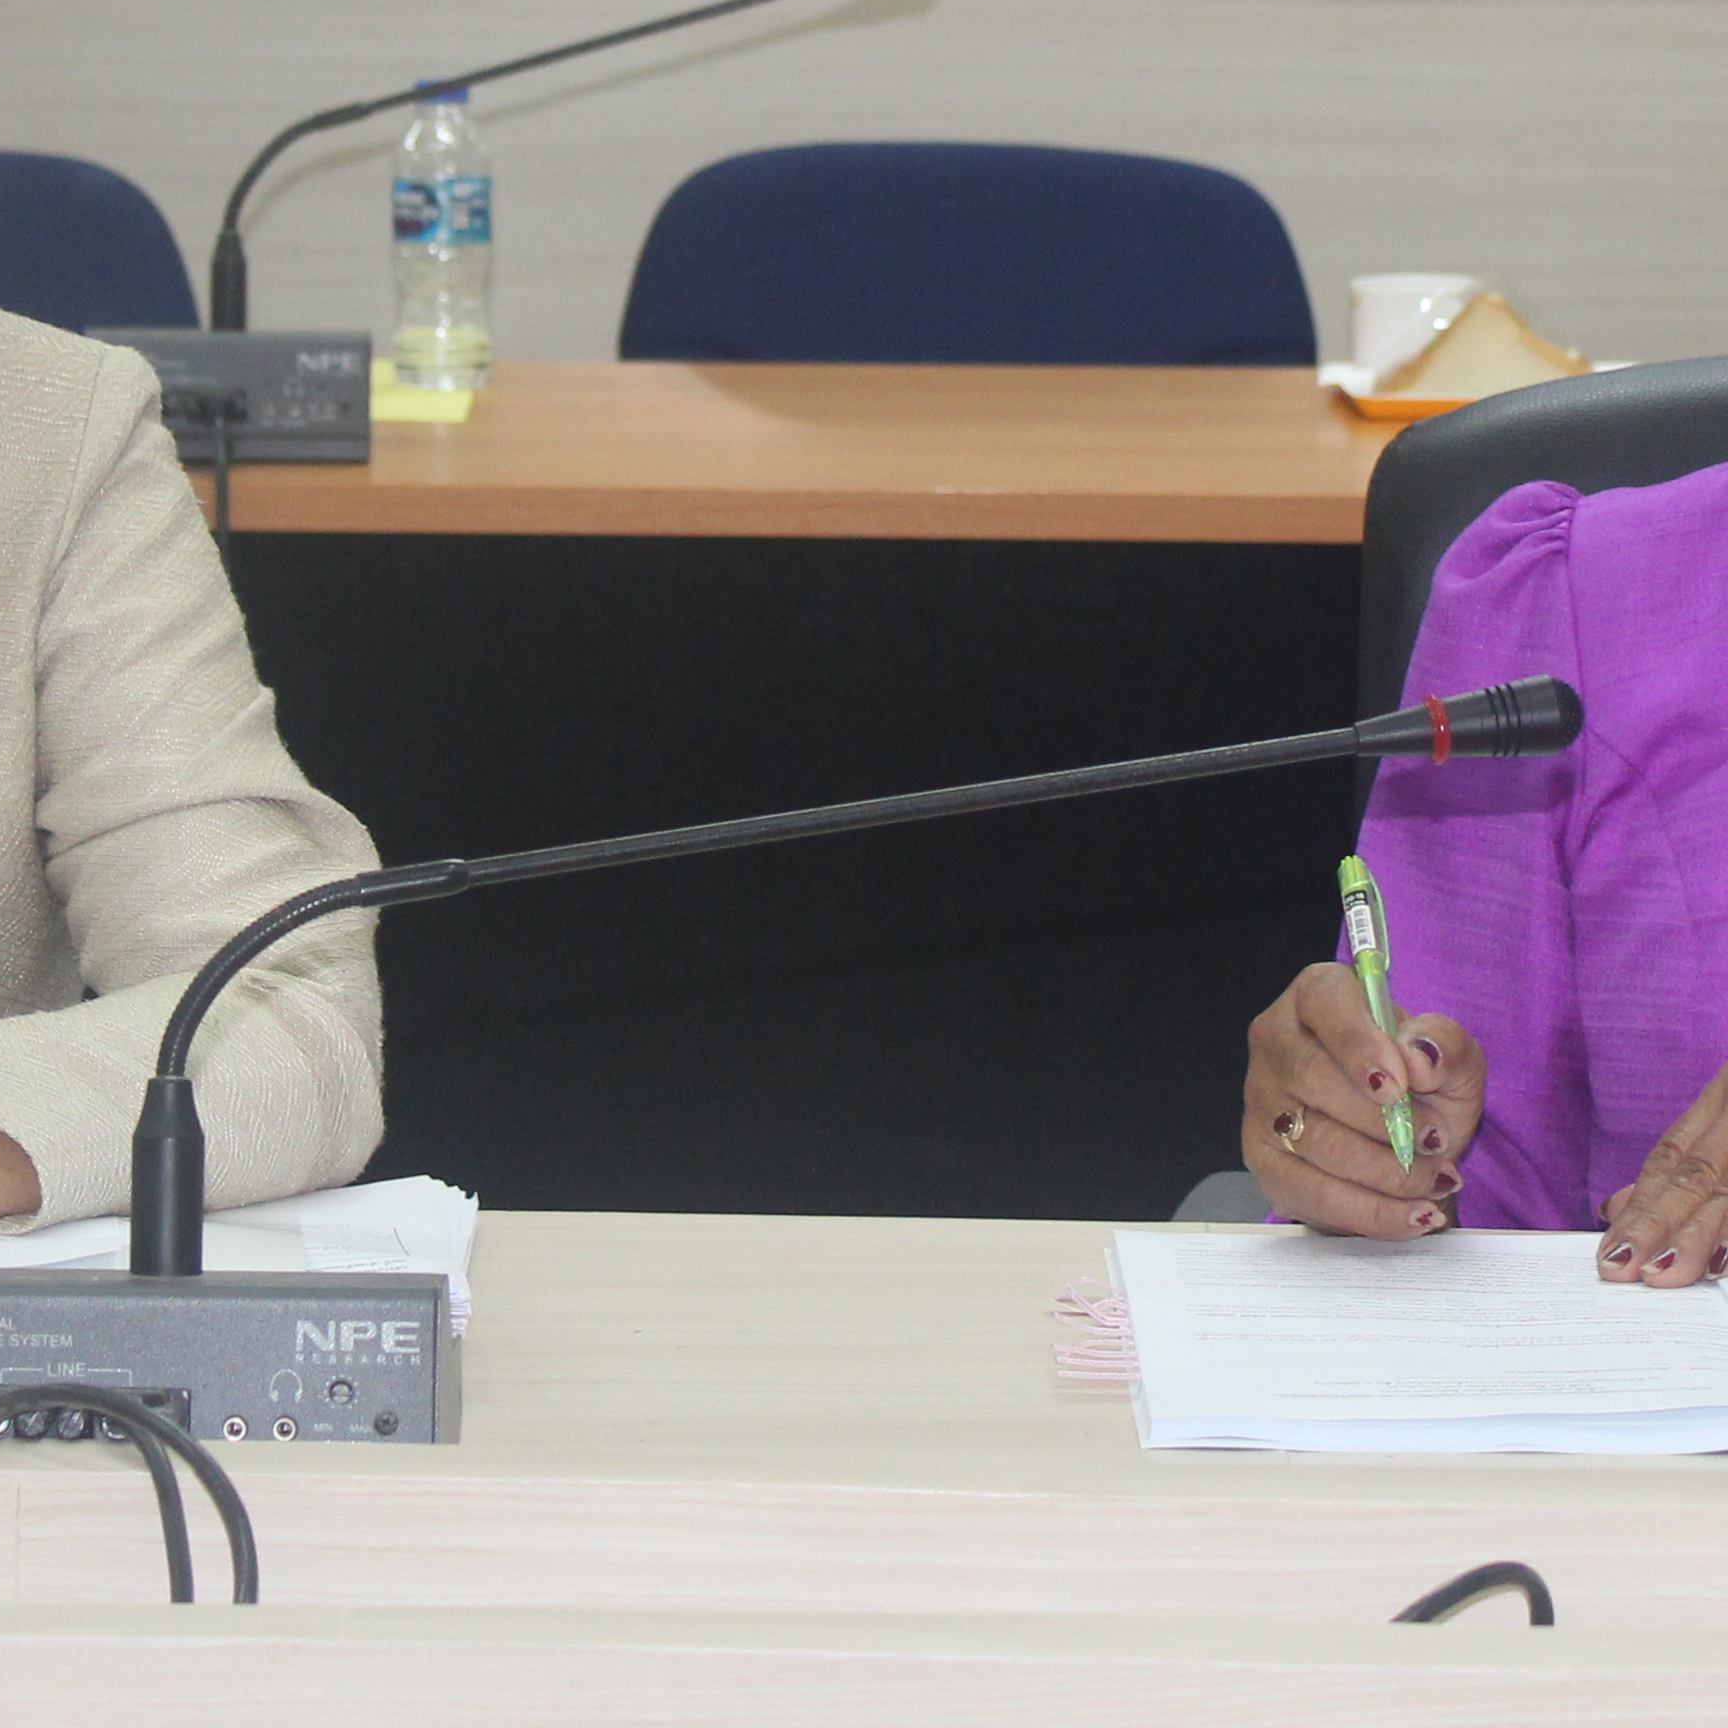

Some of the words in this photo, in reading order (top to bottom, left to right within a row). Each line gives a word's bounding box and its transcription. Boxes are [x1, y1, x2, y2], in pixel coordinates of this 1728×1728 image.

[9, 1333, 73, 1348] SYSTEM
[295, 1320, 421, 1353] NPE
[46, 1362, 87, 1377] LINE
